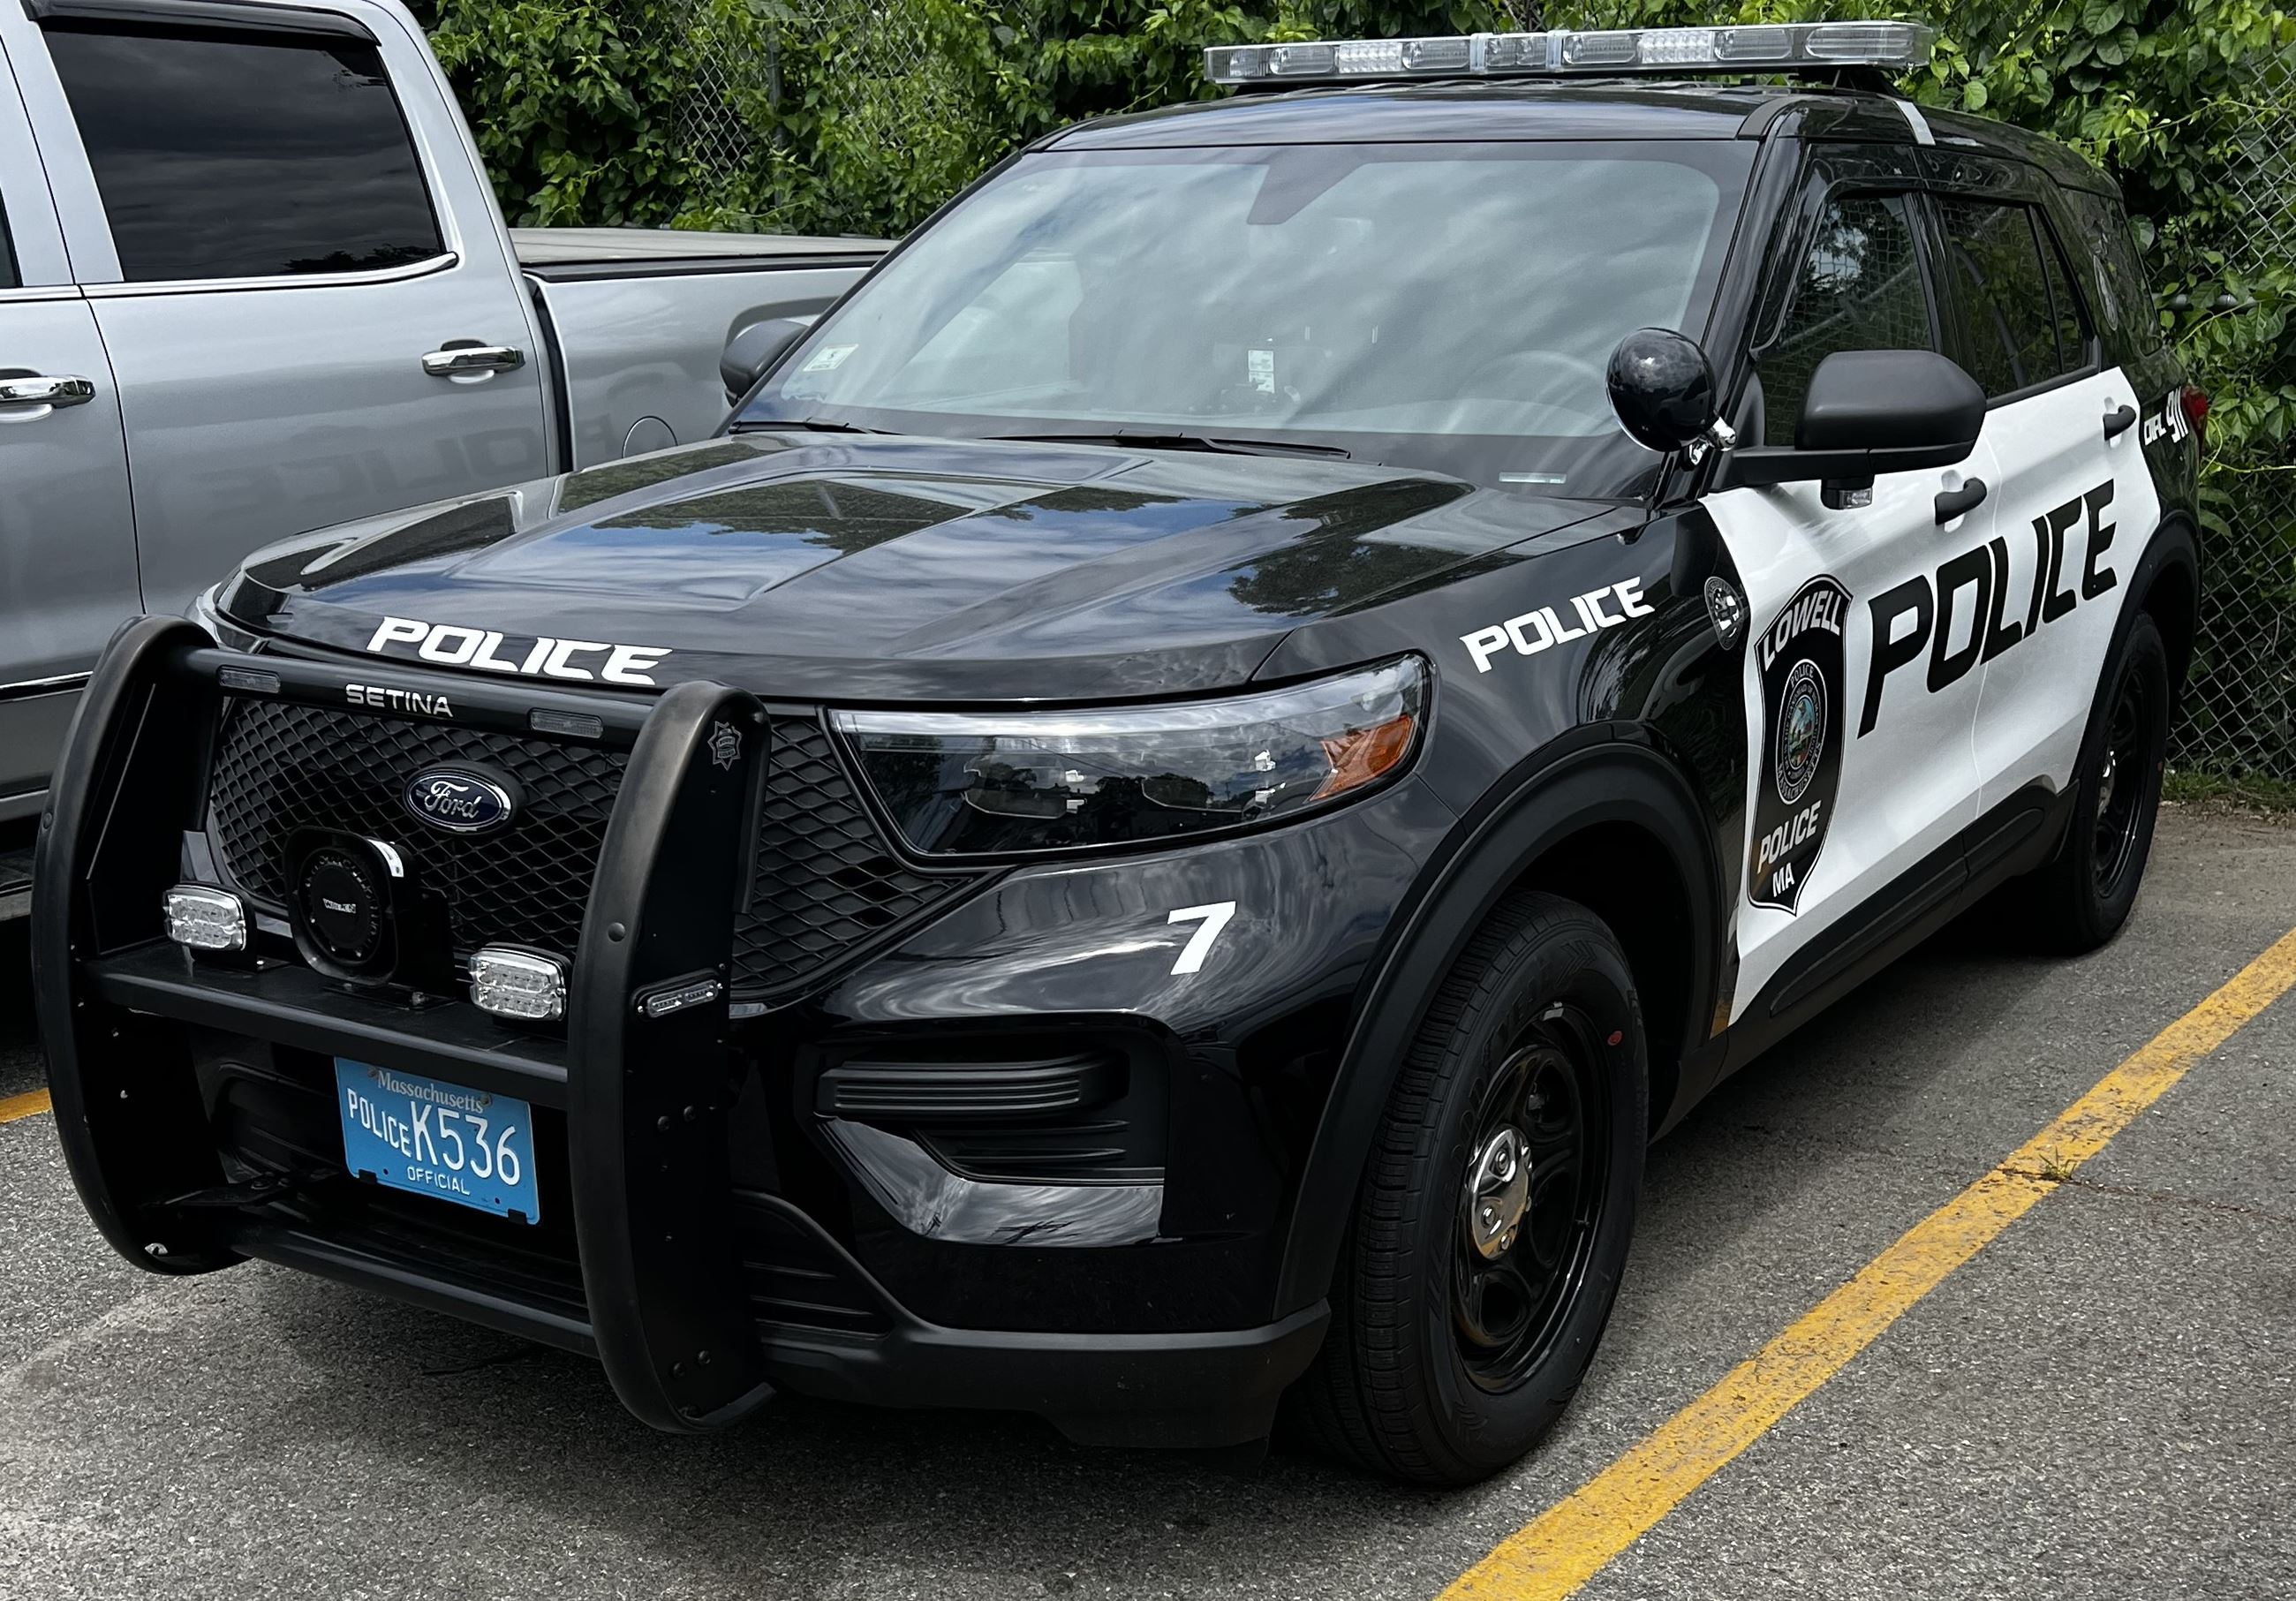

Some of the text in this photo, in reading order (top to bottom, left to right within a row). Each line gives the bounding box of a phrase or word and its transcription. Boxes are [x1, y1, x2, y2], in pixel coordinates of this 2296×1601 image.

[2166, 386, 2188, 443] 911
[1459, 576, 1655, 674] POLICE
[1764, 590, 1841, 671] LOWELL
[1856, 478, 2118, 740] POLICE
[366, 616, 673, 685] POLICE
[1790, 664, 1814, 688] POLICE
[345, 683, 454, 718] SETINA
[424, 781, 483, 819] Ford
[1757, 800, 1822, 874] POLICE
[1772, 862, 1795, 897] MA
[1167, 901, 1236, 976] 7
[377, 1069, 484, 1114] Massachusetts
[347, 1088, 521, 1186] POLICE K536
[406, 1166, 471, 1196] OFFICIAL
